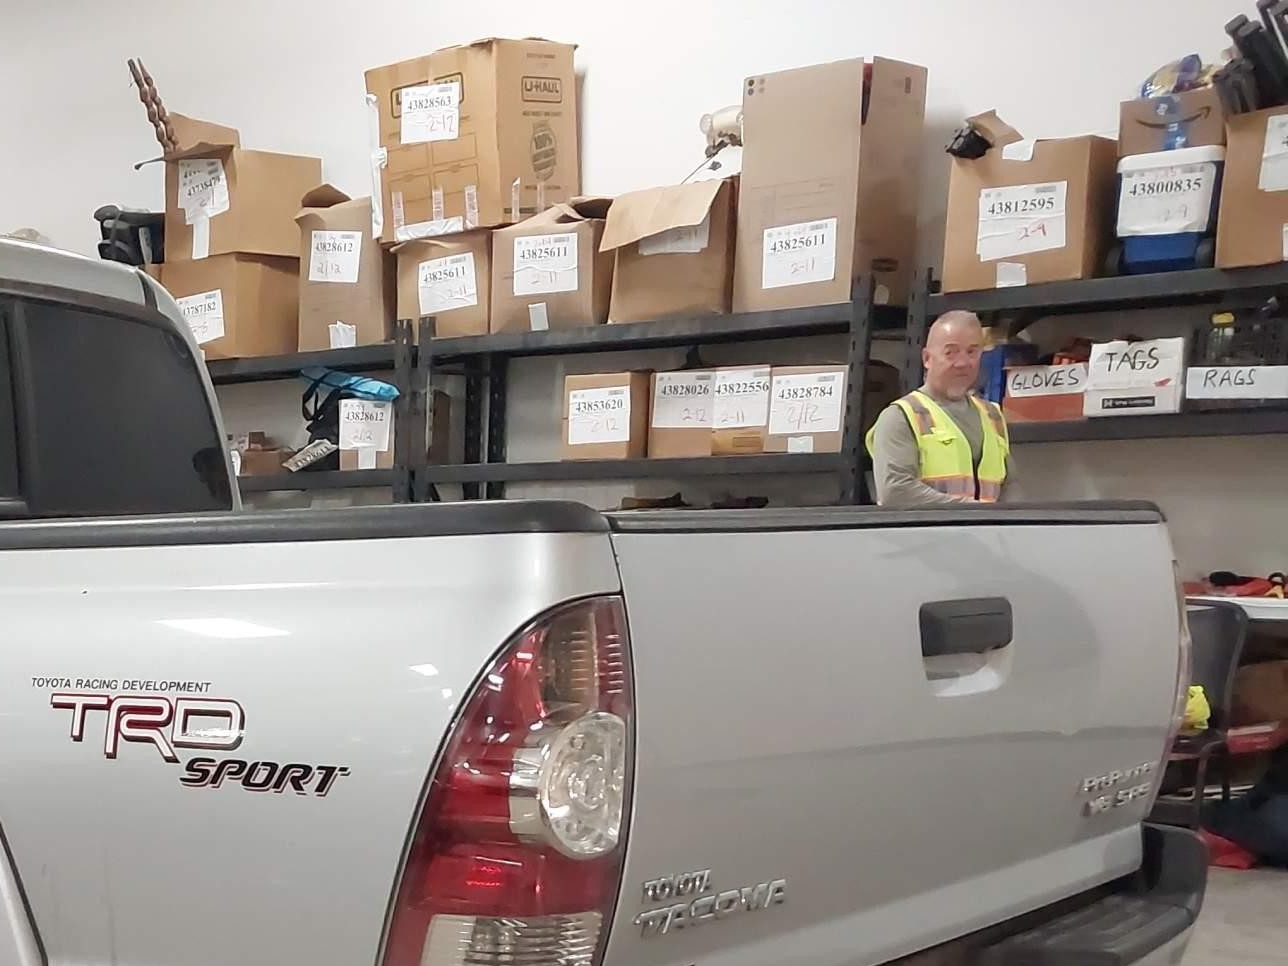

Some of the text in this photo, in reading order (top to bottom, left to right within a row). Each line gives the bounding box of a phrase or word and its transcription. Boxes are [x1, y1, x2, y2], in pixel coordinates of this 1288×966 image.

[407, 95, 452, 111] 43828563
[1129, 178, 1203, 196] 43800835
[988, 197, 1055, 214] 43812595
[315, 241, 353, 253] 43828612
[770, 233, 825, 253] 43825611
[520, 246, 567, 260] 43825611
[423, 266, 466, 283] 43825611
[1106, 347, 1160, 372] TAGS
[1011, 367, 1080, 391] GLOVES
[1203, 368, 1257, 389] RAGS
[661, 384, 710, 396] 43828026
[715, 381, 769, 395] 43822556
[778, 384, 833, 400] 43828784
[575, 398, 623, 413] 43853620
[344, 411, 385, 422] 43828612
[31, 677, 212, 693] TOYOTA RACING DEVELOPMENT
[50, 693, 245, 764] TRD
[179, 757, 351, 797] SPORT
